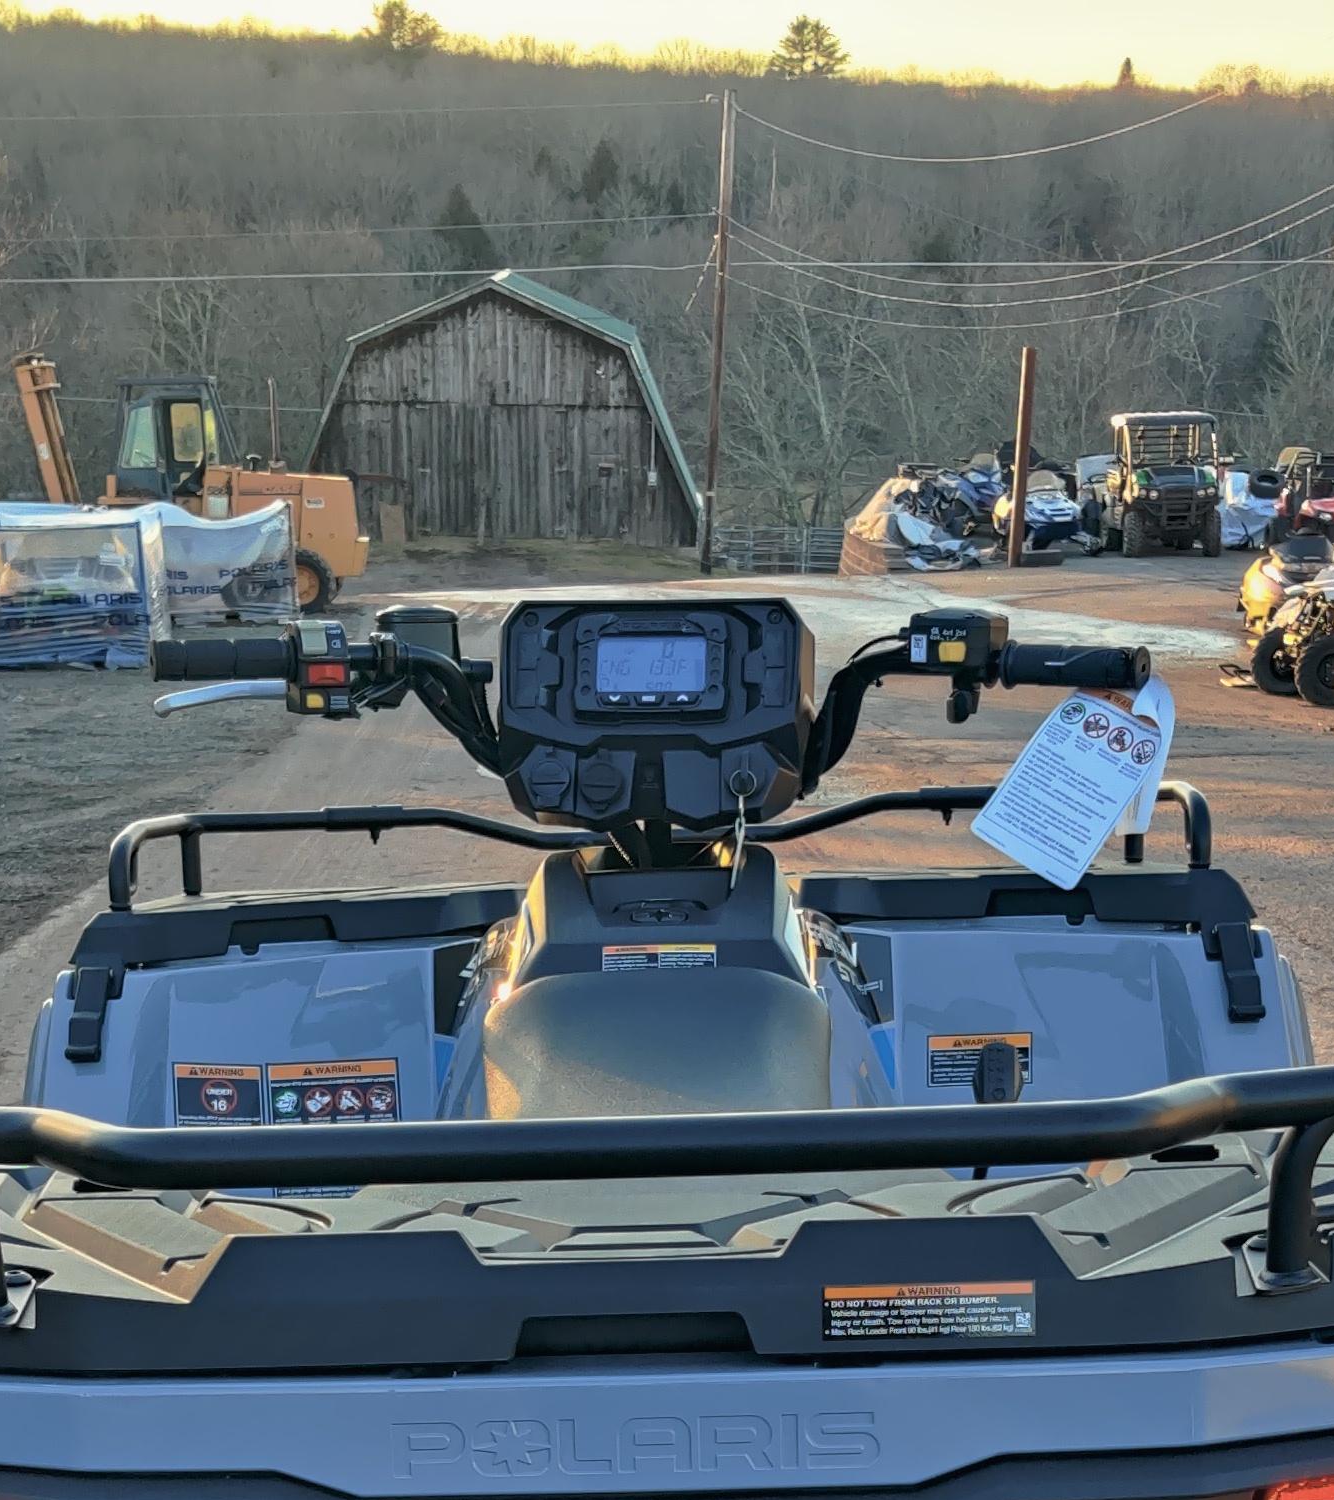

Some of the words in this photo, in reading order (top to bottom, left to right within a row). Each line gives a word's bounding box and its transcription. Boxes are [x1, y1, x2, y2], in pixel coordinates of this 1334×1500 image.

[199, 1067, 245, 1077] WARNING
[315, 1064, 362, 1074] WARNING
[211, 1099, 228, 1111] 16
[907, 1286, 961, 1296] WARNING
[846, 1300, 865, 1308] NOT
[867, 1299, 887, 1307] TOW
[889, 1299, 916, 1307] FROM
[917, 1298, 942, 1306] RACK
[944, 1297, 957, 1305] OR
[959, 1296, 999, 1305] BUMPER.
[391, 1411, 881, 1479] POLARIS
